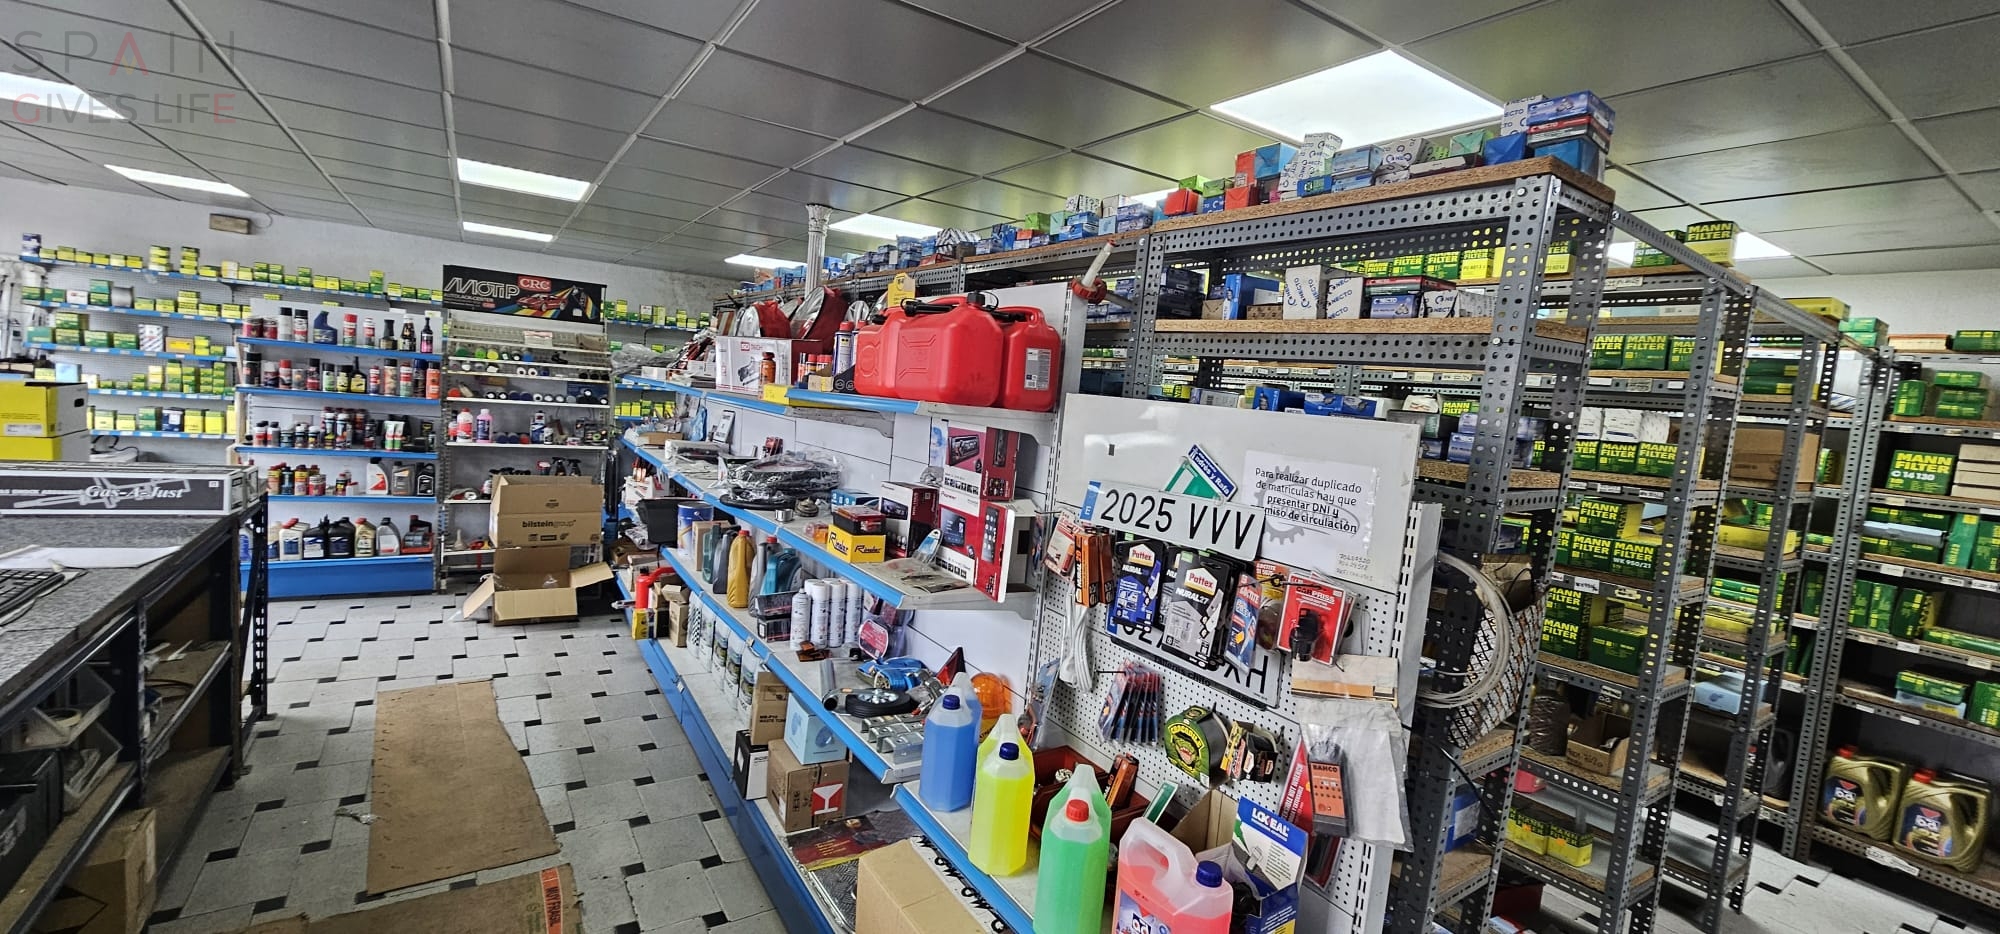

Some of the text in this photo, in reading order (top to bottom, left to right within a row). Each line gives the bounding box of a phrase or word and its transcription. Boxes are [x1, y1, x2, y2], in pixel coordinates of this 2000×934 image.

[1688, 223, 1731, 233] MANN
[1688, 231, 1730, 241] FILTER
[1548, 246, 1569, 254] TER
[1394, 257, 1422, 266] FILTER
[1428, 254, 1458, 265] FILTER
[520, 279, 551, 289] CRC
[1331, 290, 1353, 304] NECTO
[1627, 335, 1666, 343] MANN
[1592, 342, 1622, 350] ILTER
[1602, 443, 1637, 451] MANN
[1640, 443, 1678, 453] MANN
[1601, 449, 1636, 458] FILTER
[1639, 450, 1677, 460] FILTER
[1896, 452, 1952, 466] MANN
[1895, 461, 1950, 474] FILTER
[1215, 479, 1230, 494] Rafa
[1255, 467, 1362, 494] Para realizar duplicado
[85, 485, 184, 499] Gas-A-Just
[1256, 480, 1267, 489] de
[1316, 490, 1335, 505] hay
[1337, 496, 1357, 507] que
[1084, 506, 1092, 516] E
[1267, 495, 1339, 518] presentar DNI y
[1581, 501, 1619, 513] MANN
[1100, 489, 1176, 532] 2025
[1189, 503, 1256, 550] VVV
[1265, 507, 1358, 533] miso de circulación
[1580, 508, 1617, 520] FILTER
[1574, 535, 1611, 547] MANN
[1573, 543, 1609, 554] FILTER
[1615, 541, 1654, 554] MANN
[1132, 549, 1152, 561] Pattex
[1614, 549, 1652, 562] FILTER
[1122, 564, 1142, 575] NURAL
[1189, 573, 1214, 588] Pattex
[1548, 593, 1580, 606] FILTER
[1549, 588, 1581, 599] MANN
[1544, 619, 1579, 633] MANN
[1543, 627, 1577, 640] FILTER
